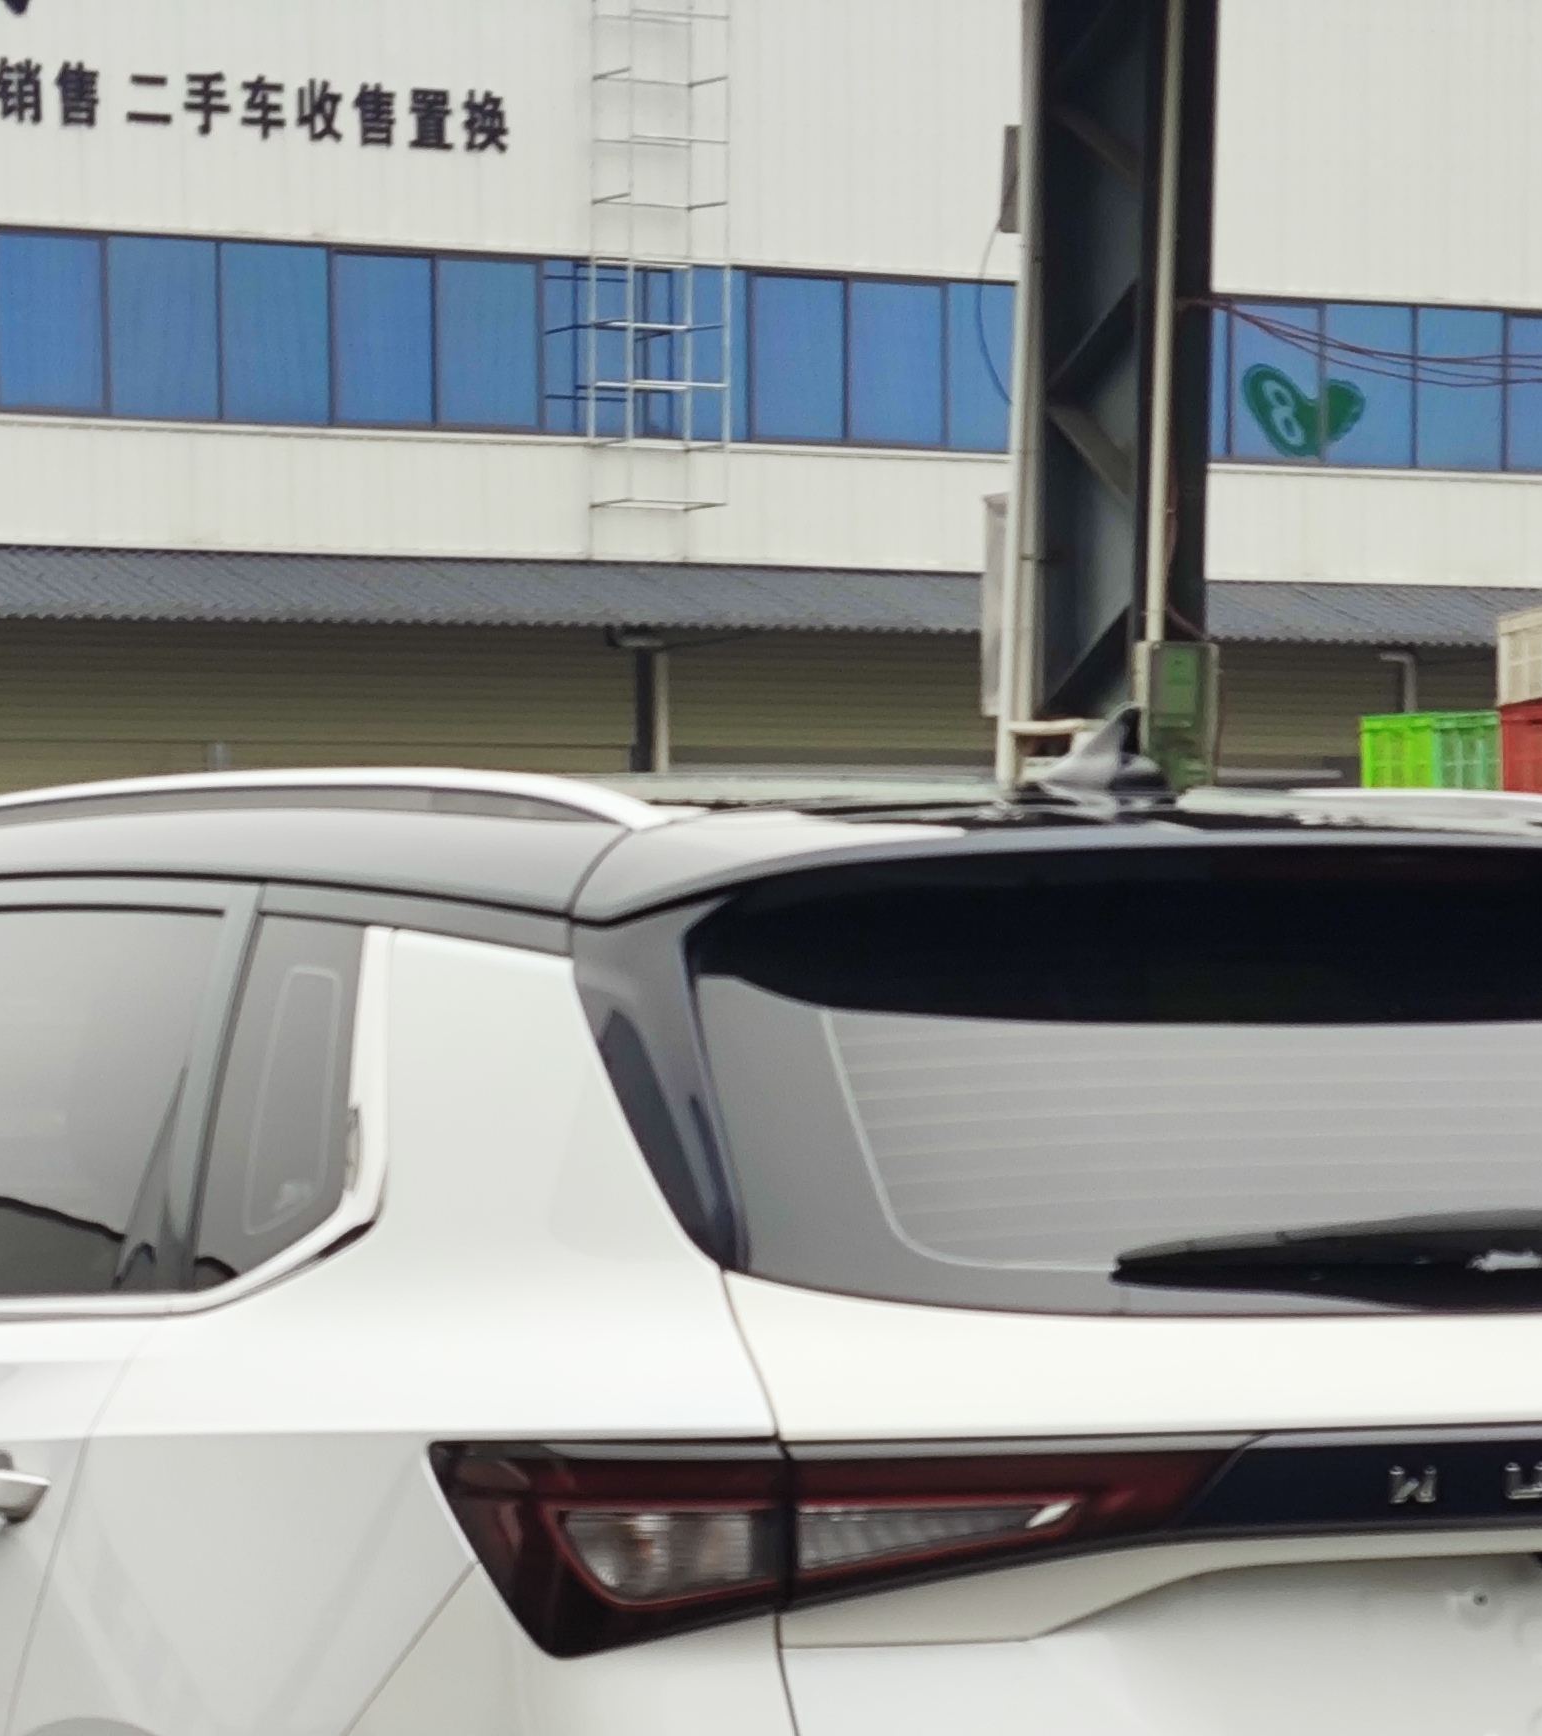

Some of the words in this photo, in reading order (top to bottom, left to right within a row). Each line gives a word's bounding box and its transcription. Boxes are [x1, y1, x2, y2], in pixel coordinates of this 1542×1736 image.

[125, 71, 509, 154] 二手车收售置换
